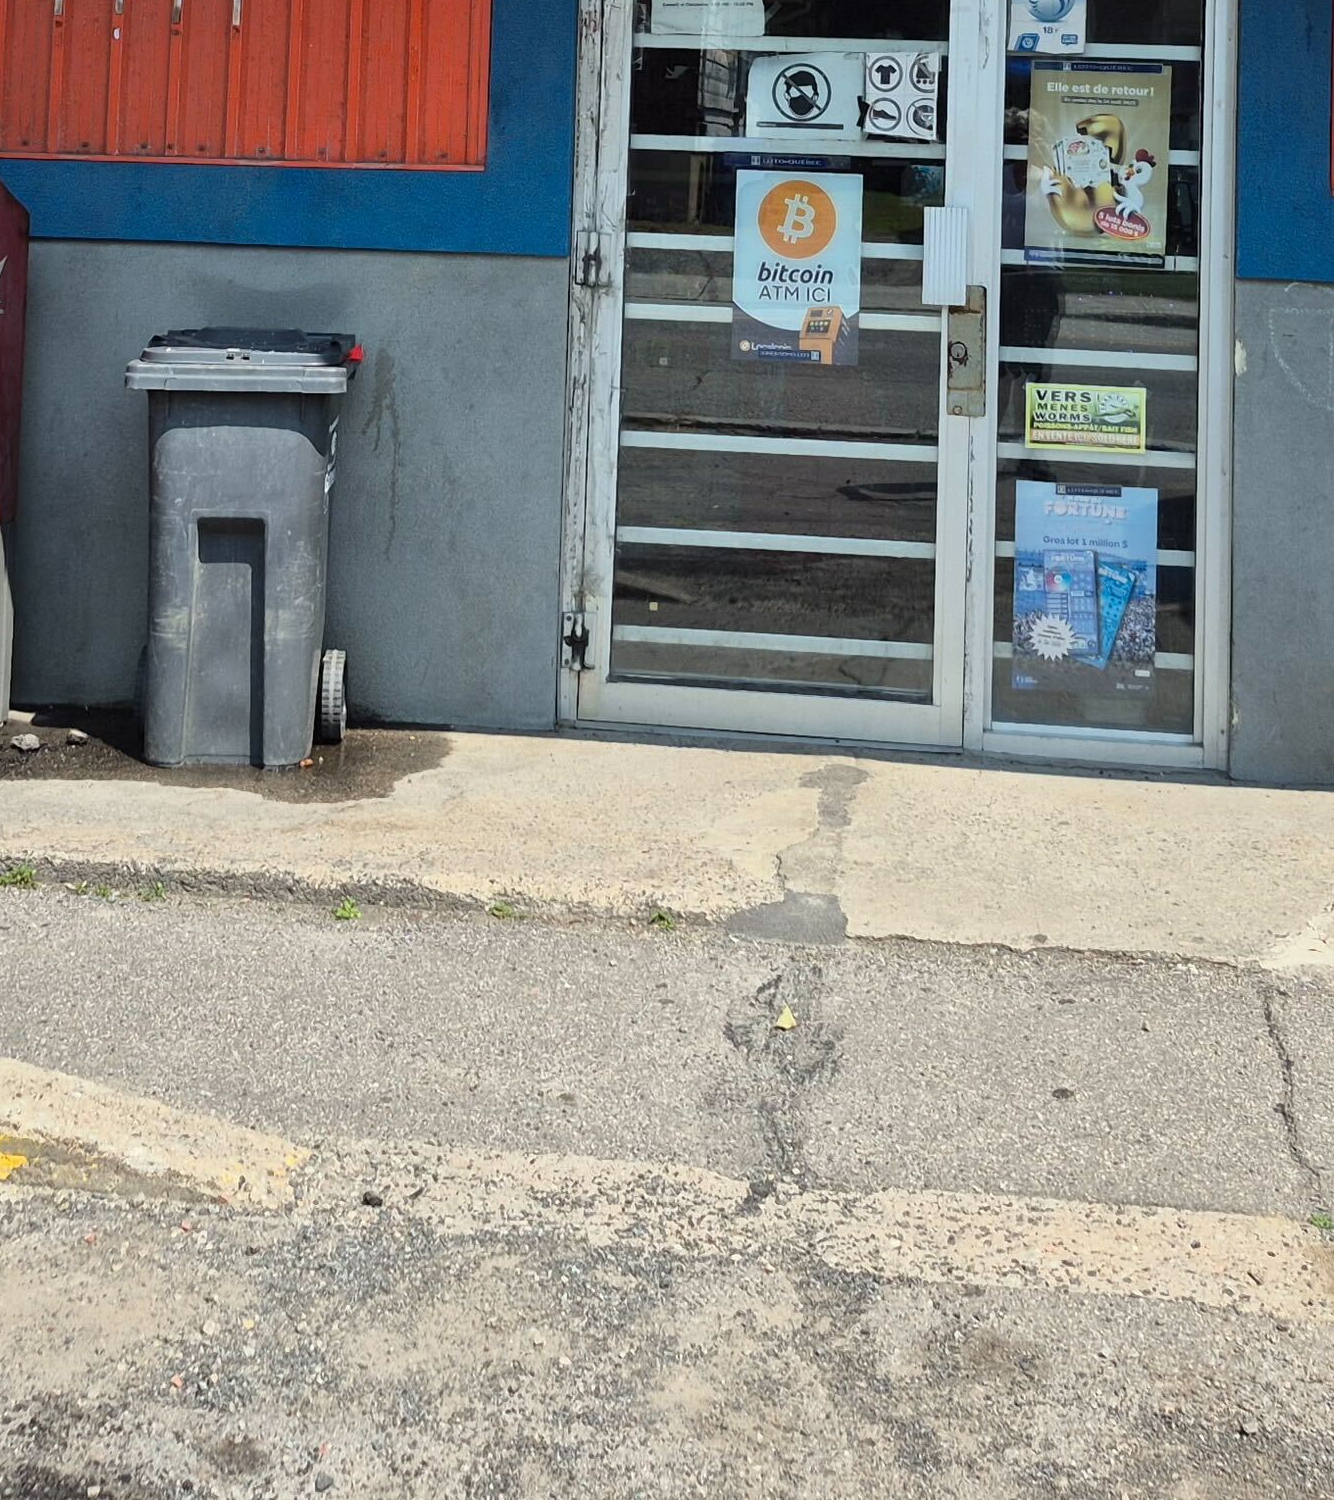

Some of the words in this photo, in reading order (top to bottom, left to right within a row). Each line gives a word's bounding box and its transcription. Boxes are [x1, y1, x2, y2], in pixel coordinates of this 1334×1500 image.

[1046, 82, 1069, 93] Elle
[1071, 84, 1090, 94] est
[1093, 84, 1108, 94] de
[757, 261, 834, 285] bitcoin
[759, 285, 800, 301] ATM
[806, 286, 831, 302] ICI
[1036, 389, 1092, 403] VERS
[1037, 402, 1088, 412] MENES
[1034, 411, 1091, 422] WORMS
[1066, 536, 1079, 546] lot
[1082, 537, 1087, 546] 1
[1088, 537, 1120, 548] million
[1122, 538, 1129, 549] $
